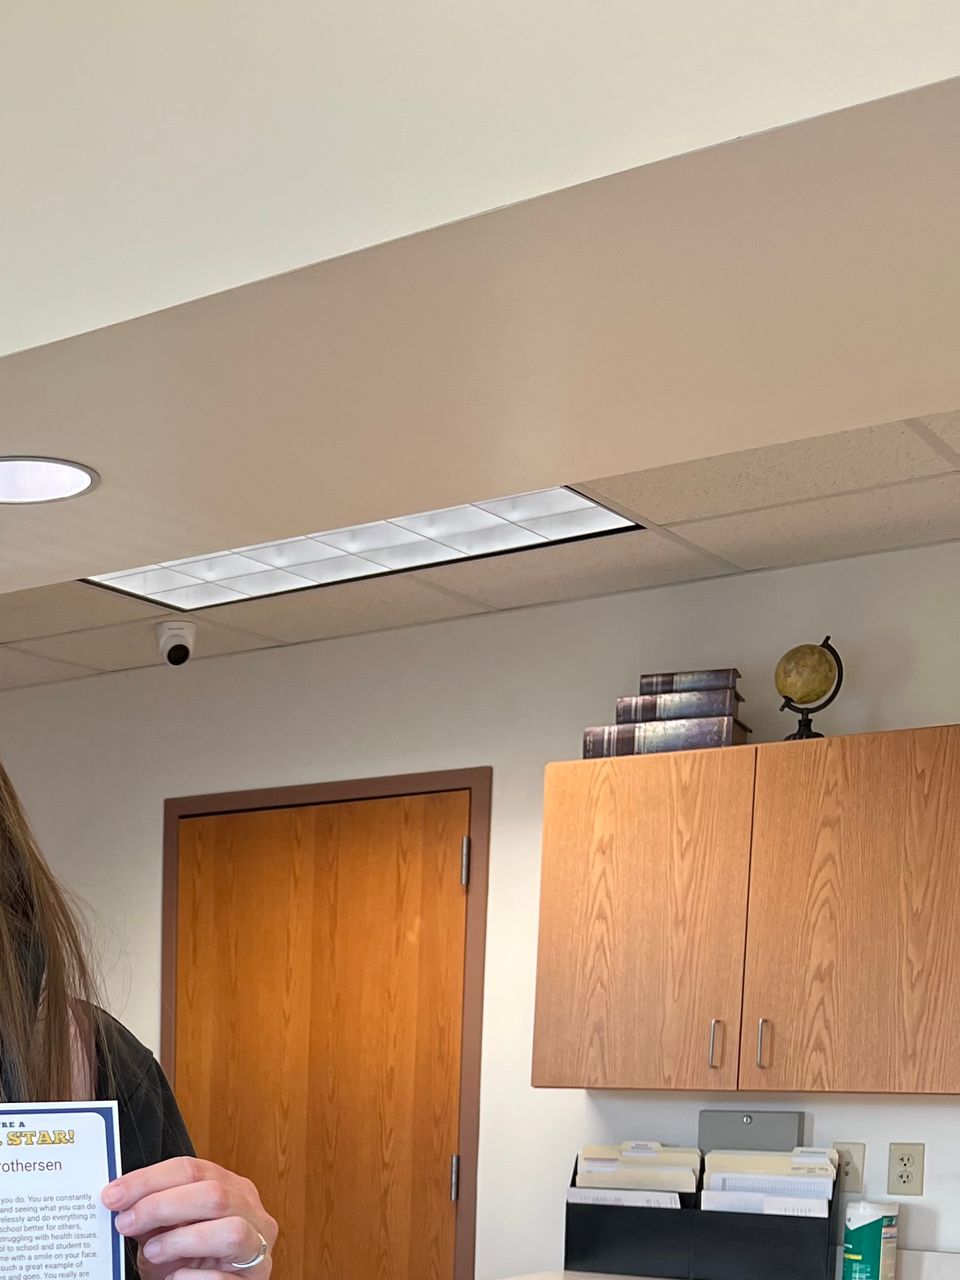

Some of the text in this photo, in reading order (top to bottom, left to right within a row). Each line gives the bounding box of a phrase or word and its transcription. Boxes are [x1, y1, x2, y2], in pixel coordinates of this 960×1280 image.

[7, 1130, 75, 1146] STAR!
[56, 1194, 92, 1202] constantly
[52, 1214, 88, 1222] everything
